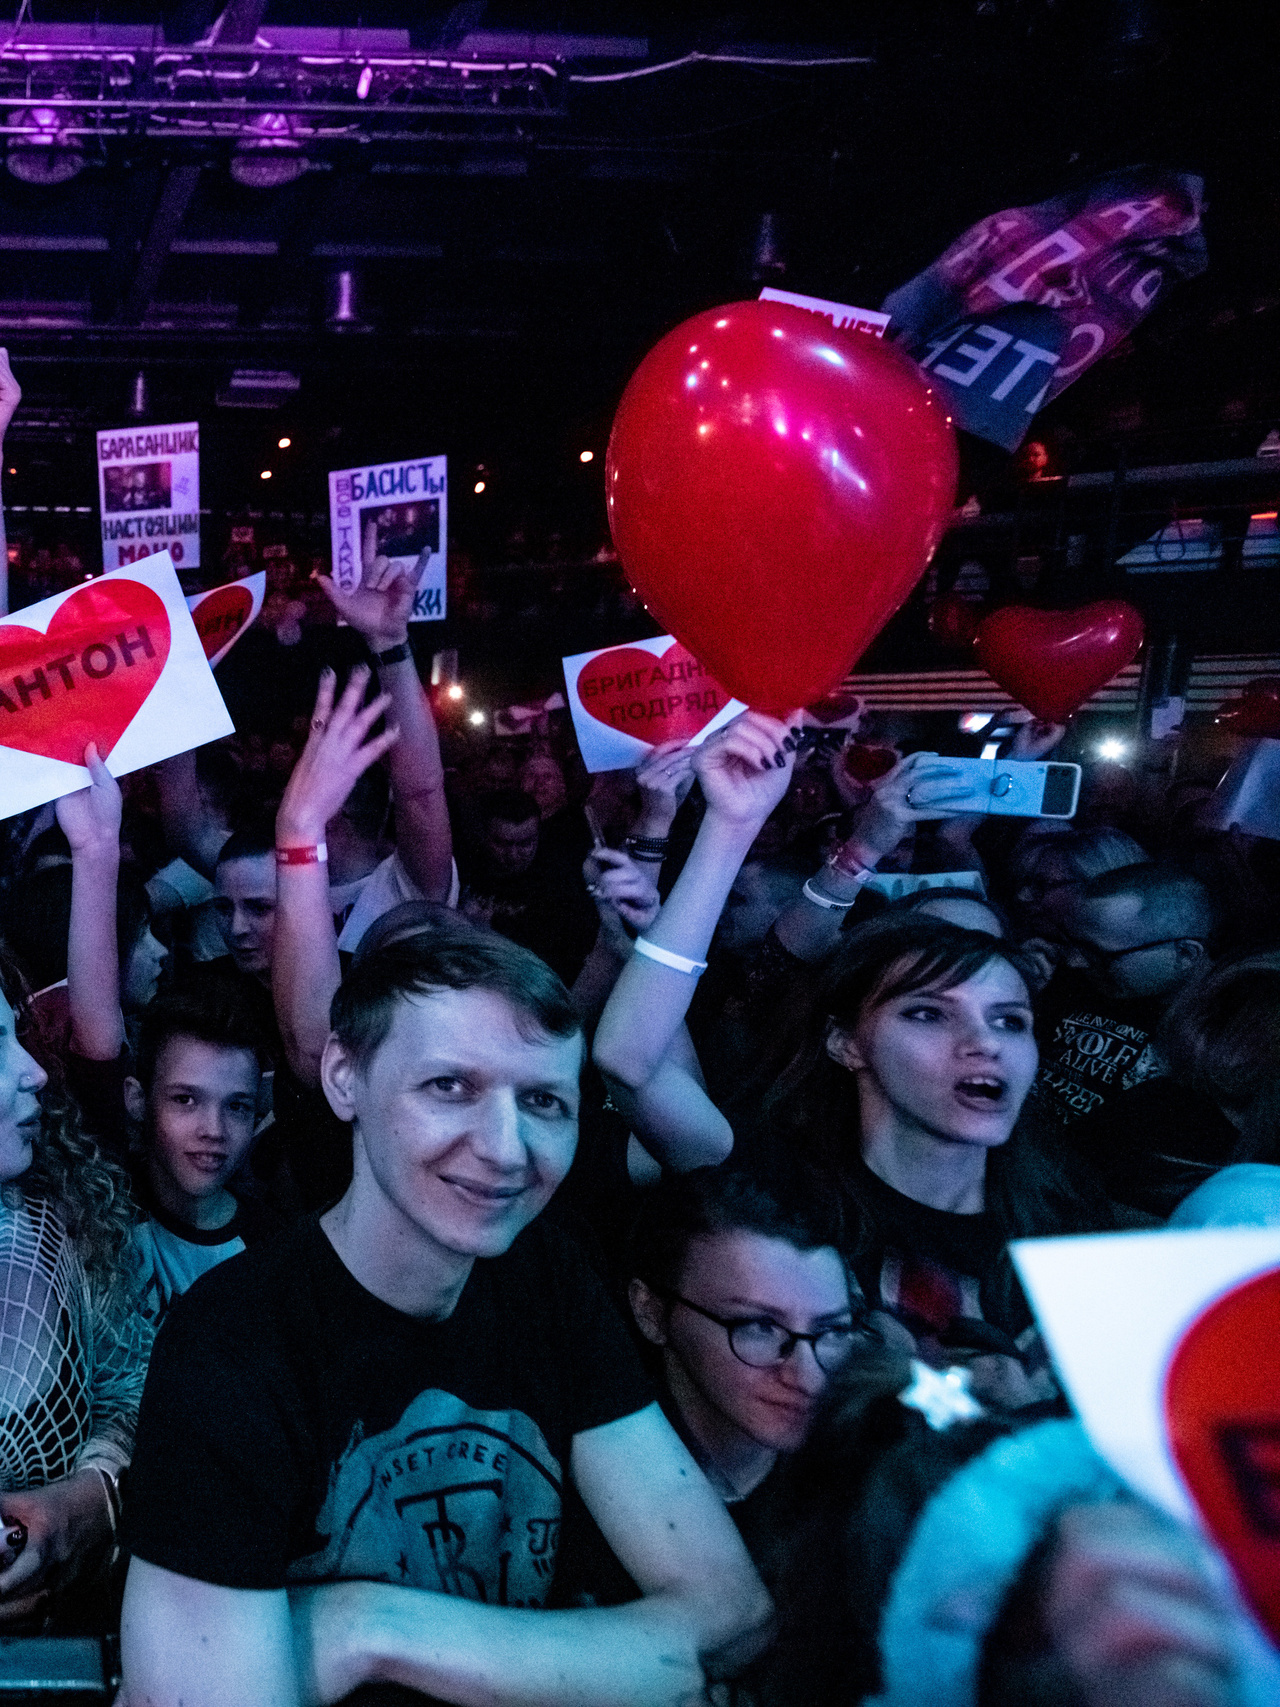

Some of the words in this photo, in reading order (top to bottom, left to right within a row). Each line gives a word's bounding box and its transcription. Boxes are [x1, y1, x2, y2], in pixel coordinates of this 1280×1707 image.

[350, 463, 445, 501] БАСИСТЫ
[582, 660, 706, 698] БРИГАДН
[609, 689, 719, 723] ПОДРЯД
[1058, 1048, 1118, 1085] ALIVE
[378, 1446, 436, 1490] NSET
[446, 1440, 509, 1474] CREE
